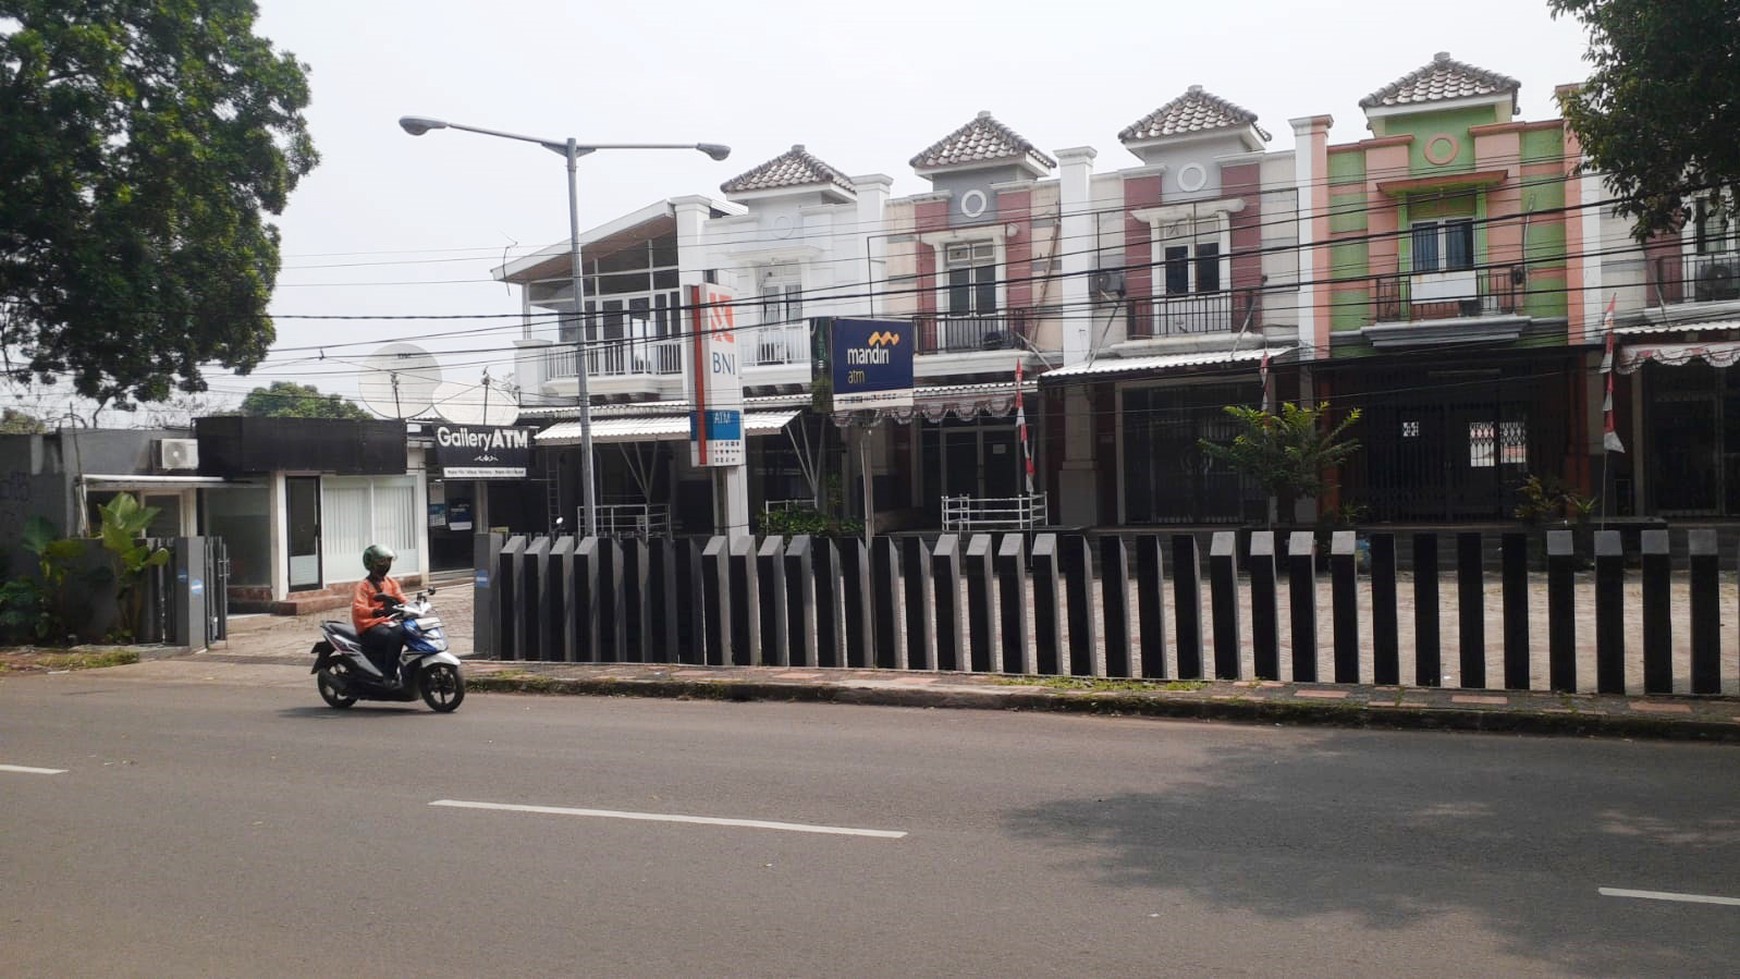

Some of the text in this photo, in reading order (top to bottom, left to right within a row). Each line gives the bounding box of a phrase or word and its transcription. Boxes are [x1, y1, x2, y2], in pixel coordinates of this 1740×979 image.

[712, 352, 736, 375] BNI
[847, 343, 889, 365] mandiri
[847, 369, 865, 385] atm
[713, 411, 731, 425] ATM
